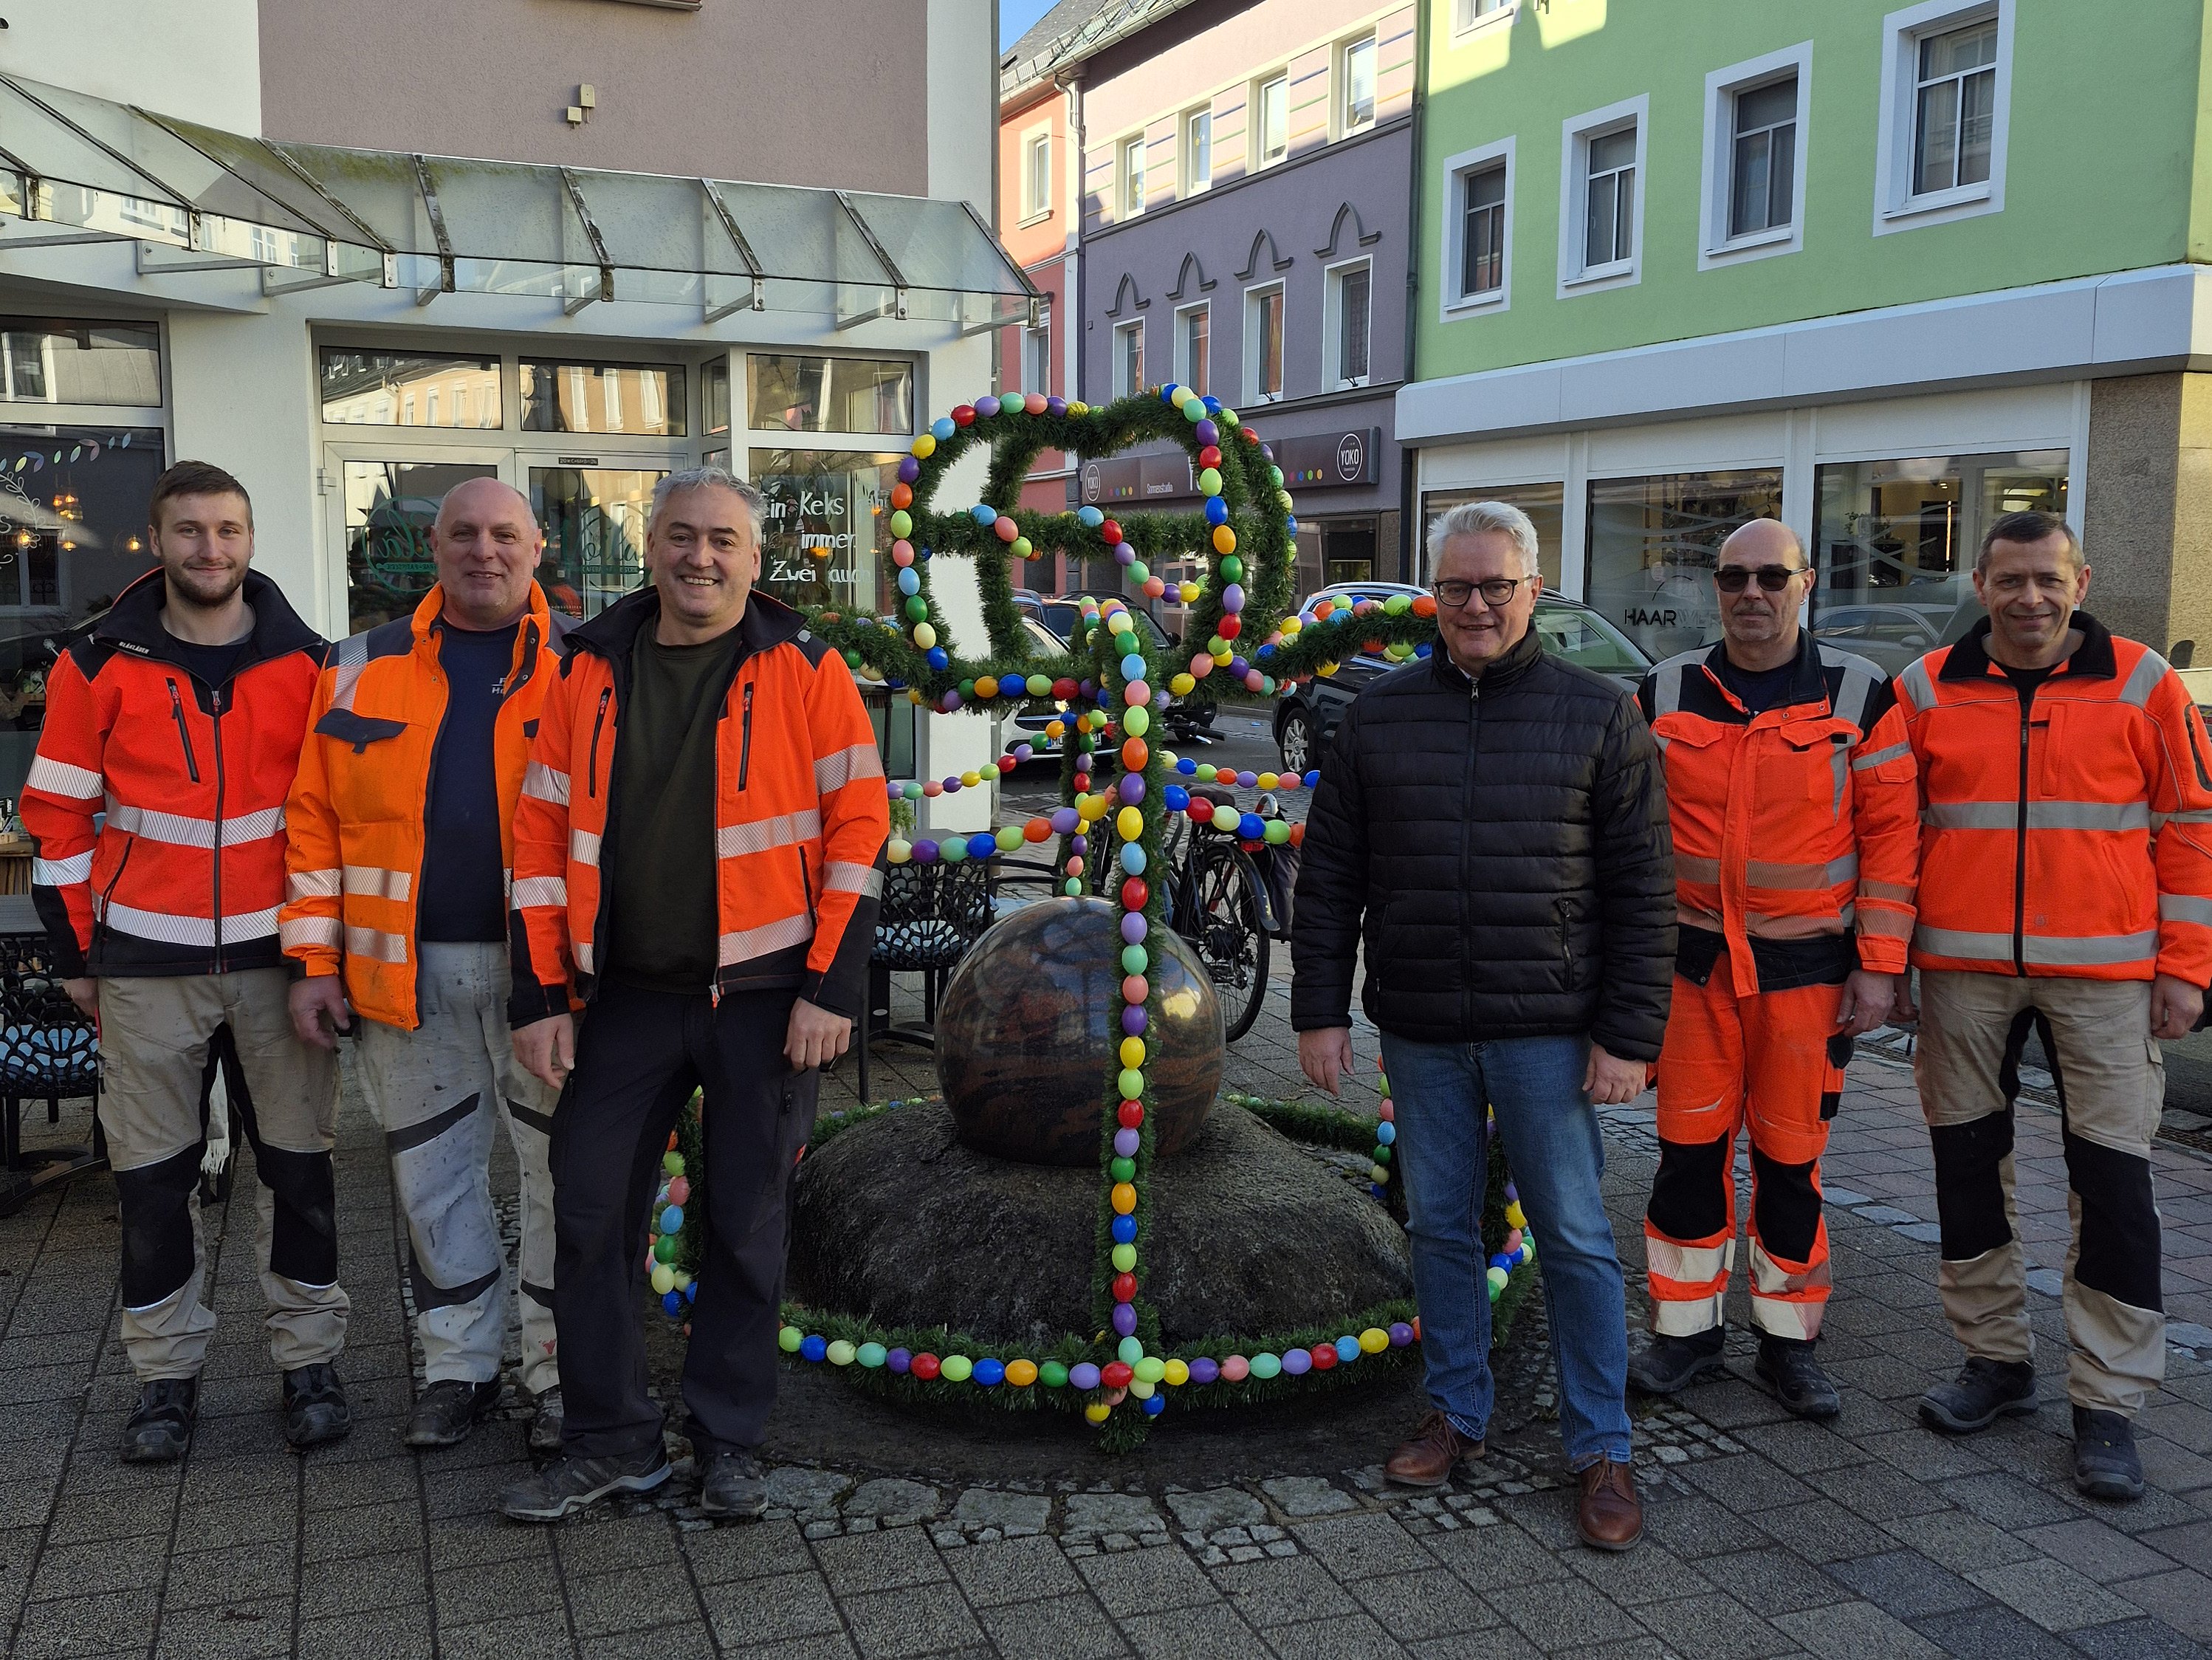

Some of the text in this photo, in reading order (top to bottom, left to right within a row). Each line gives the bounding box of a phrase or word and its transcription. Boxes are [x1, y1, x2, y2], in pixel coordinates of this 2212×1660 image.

[1341, 448, 1359, 466] YOKO
[800, 490, 845, 517] Keks
[769, 559, 817, 582] Zwei
